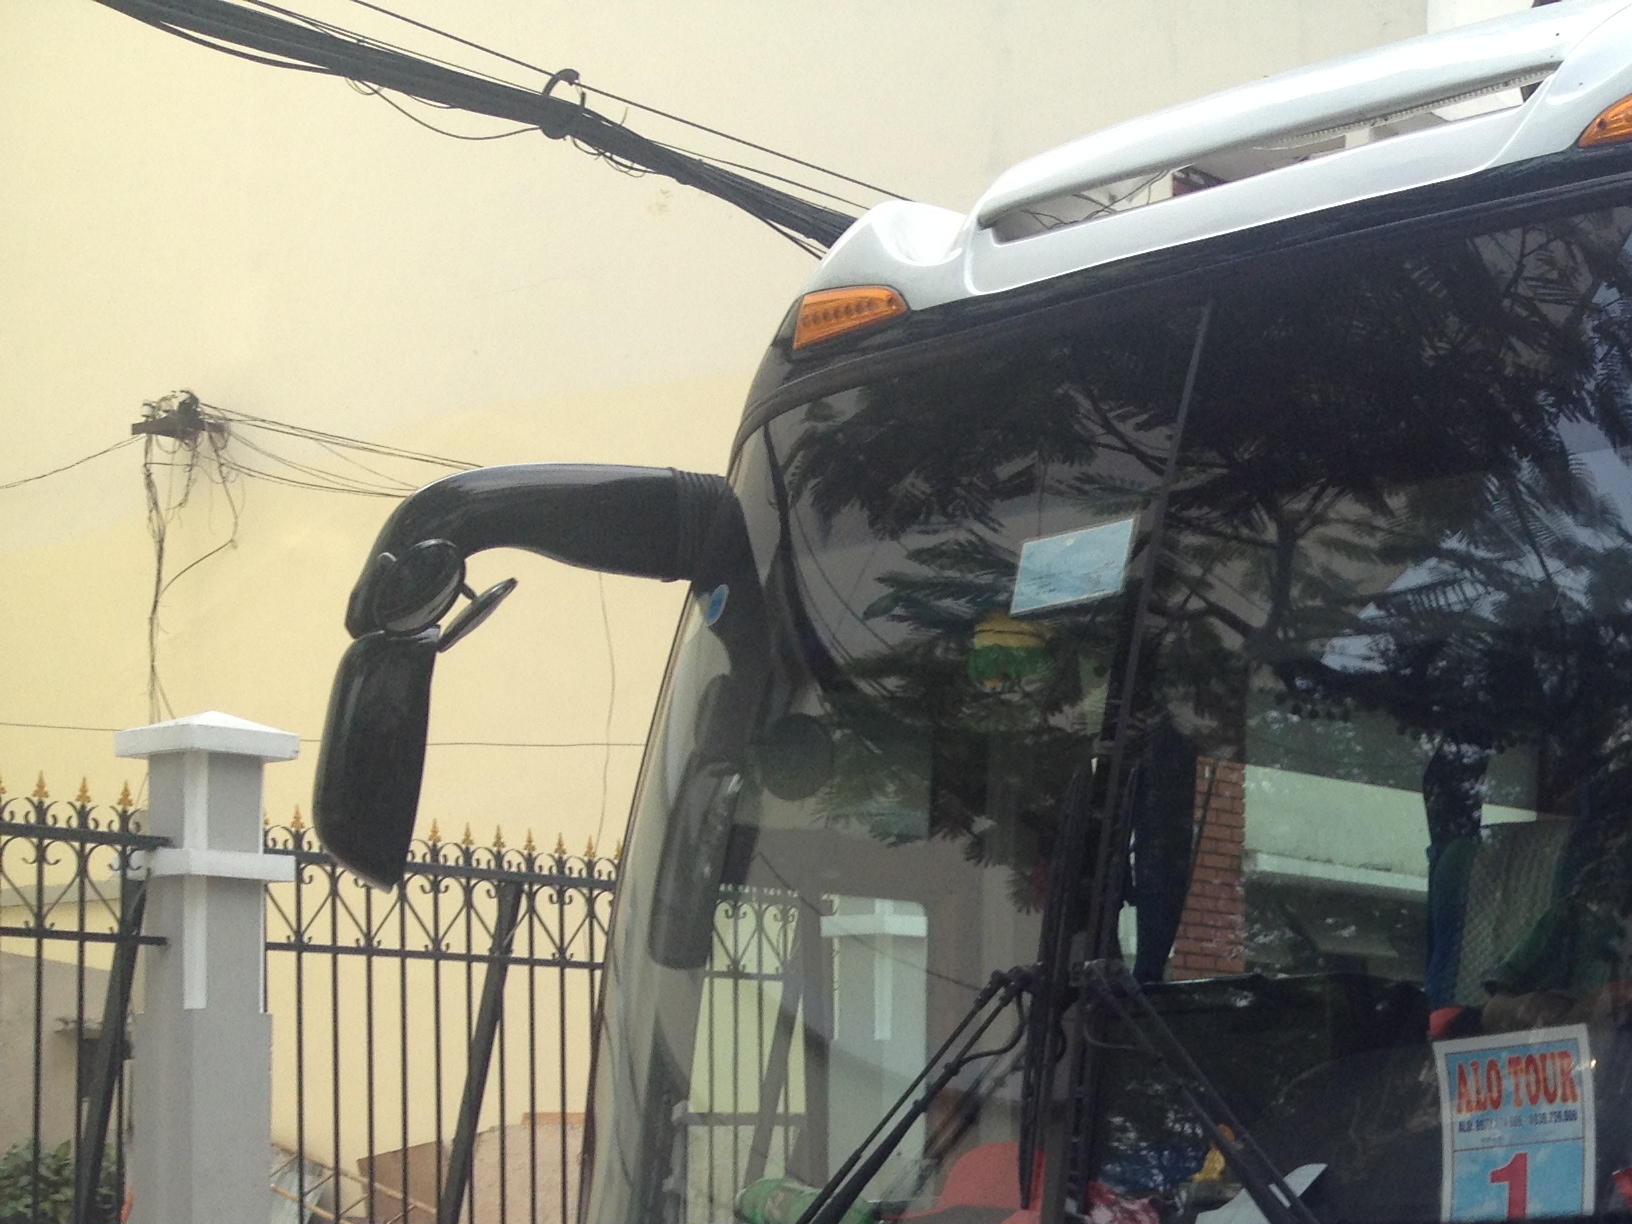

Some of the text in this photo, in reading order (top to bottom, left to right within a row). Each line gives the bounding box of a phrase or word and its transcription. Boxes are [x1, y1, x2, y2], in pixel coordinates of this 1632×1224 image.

[1456, 1050, 1579, 1115] ALO TOUR
[1490, 1152, 1528, 1219] 1
